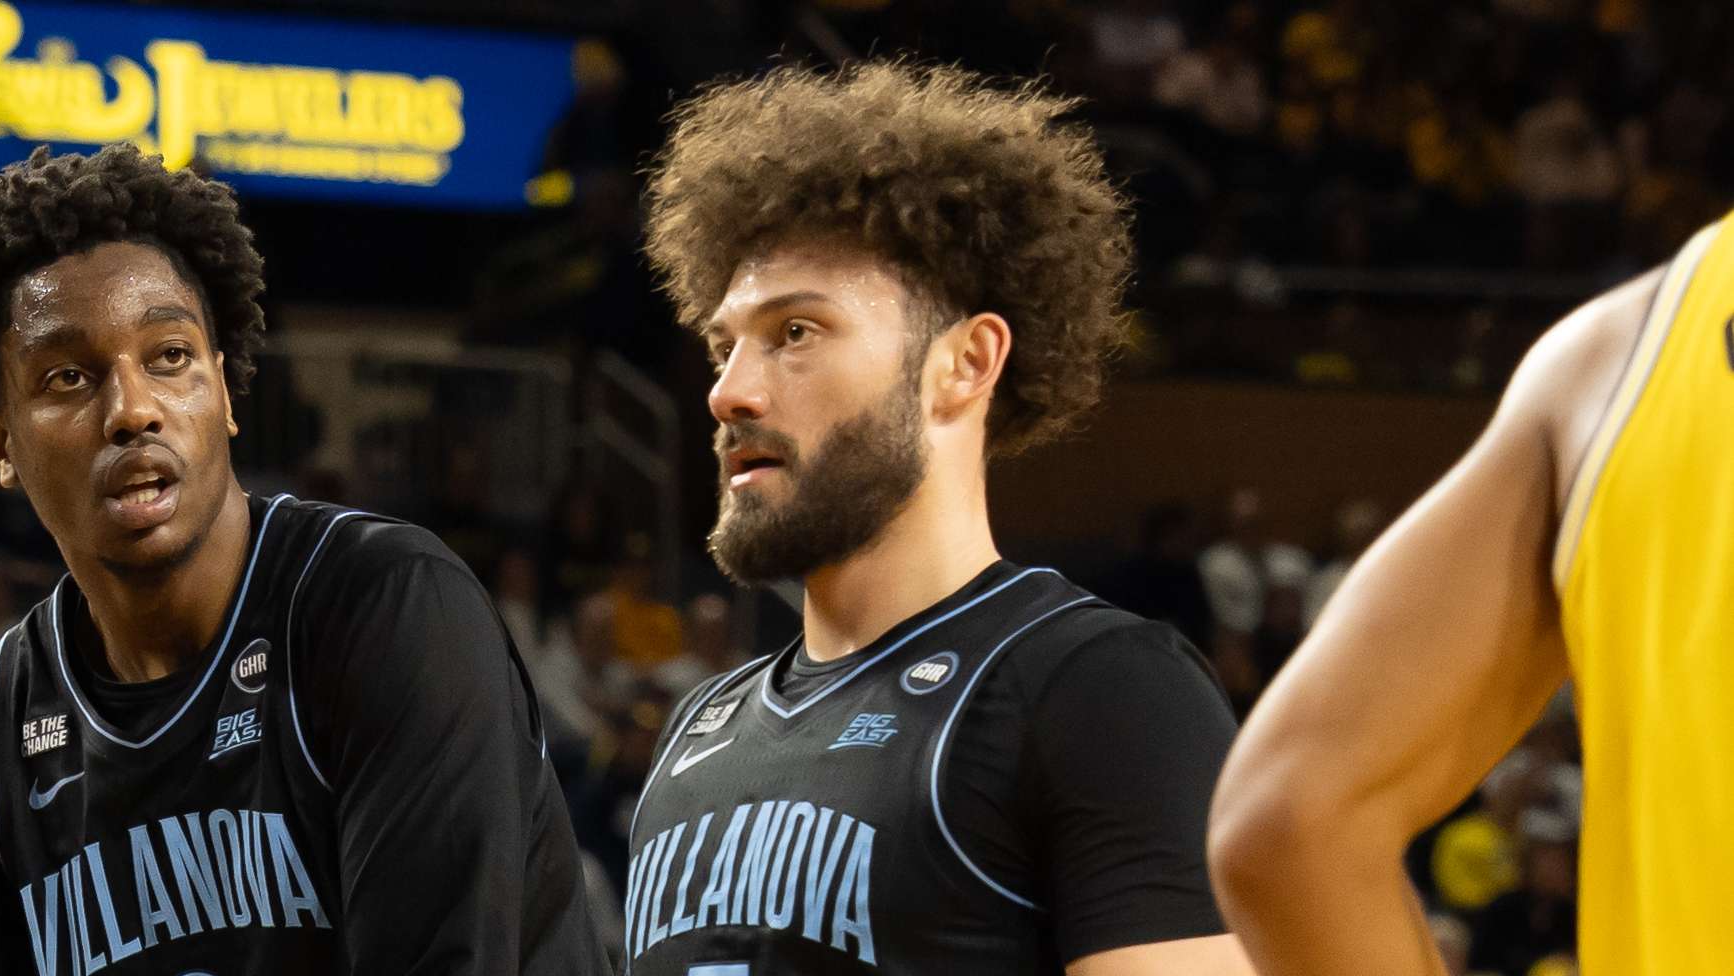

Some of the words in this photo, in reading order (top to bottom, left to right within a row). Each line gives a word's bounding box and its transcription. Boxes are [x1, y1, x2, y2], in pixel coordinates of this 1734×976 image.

[239, 652, 267, 679] GHR
[911, 662, 948, 683] GHR
[23, 721, 37, 740] BE
[41, 714, 68, 734] THE
[217, 708, 257, 734] BIG
[850, 713, 897, 728] BIG
[836, 728, 899, 742] EAST
